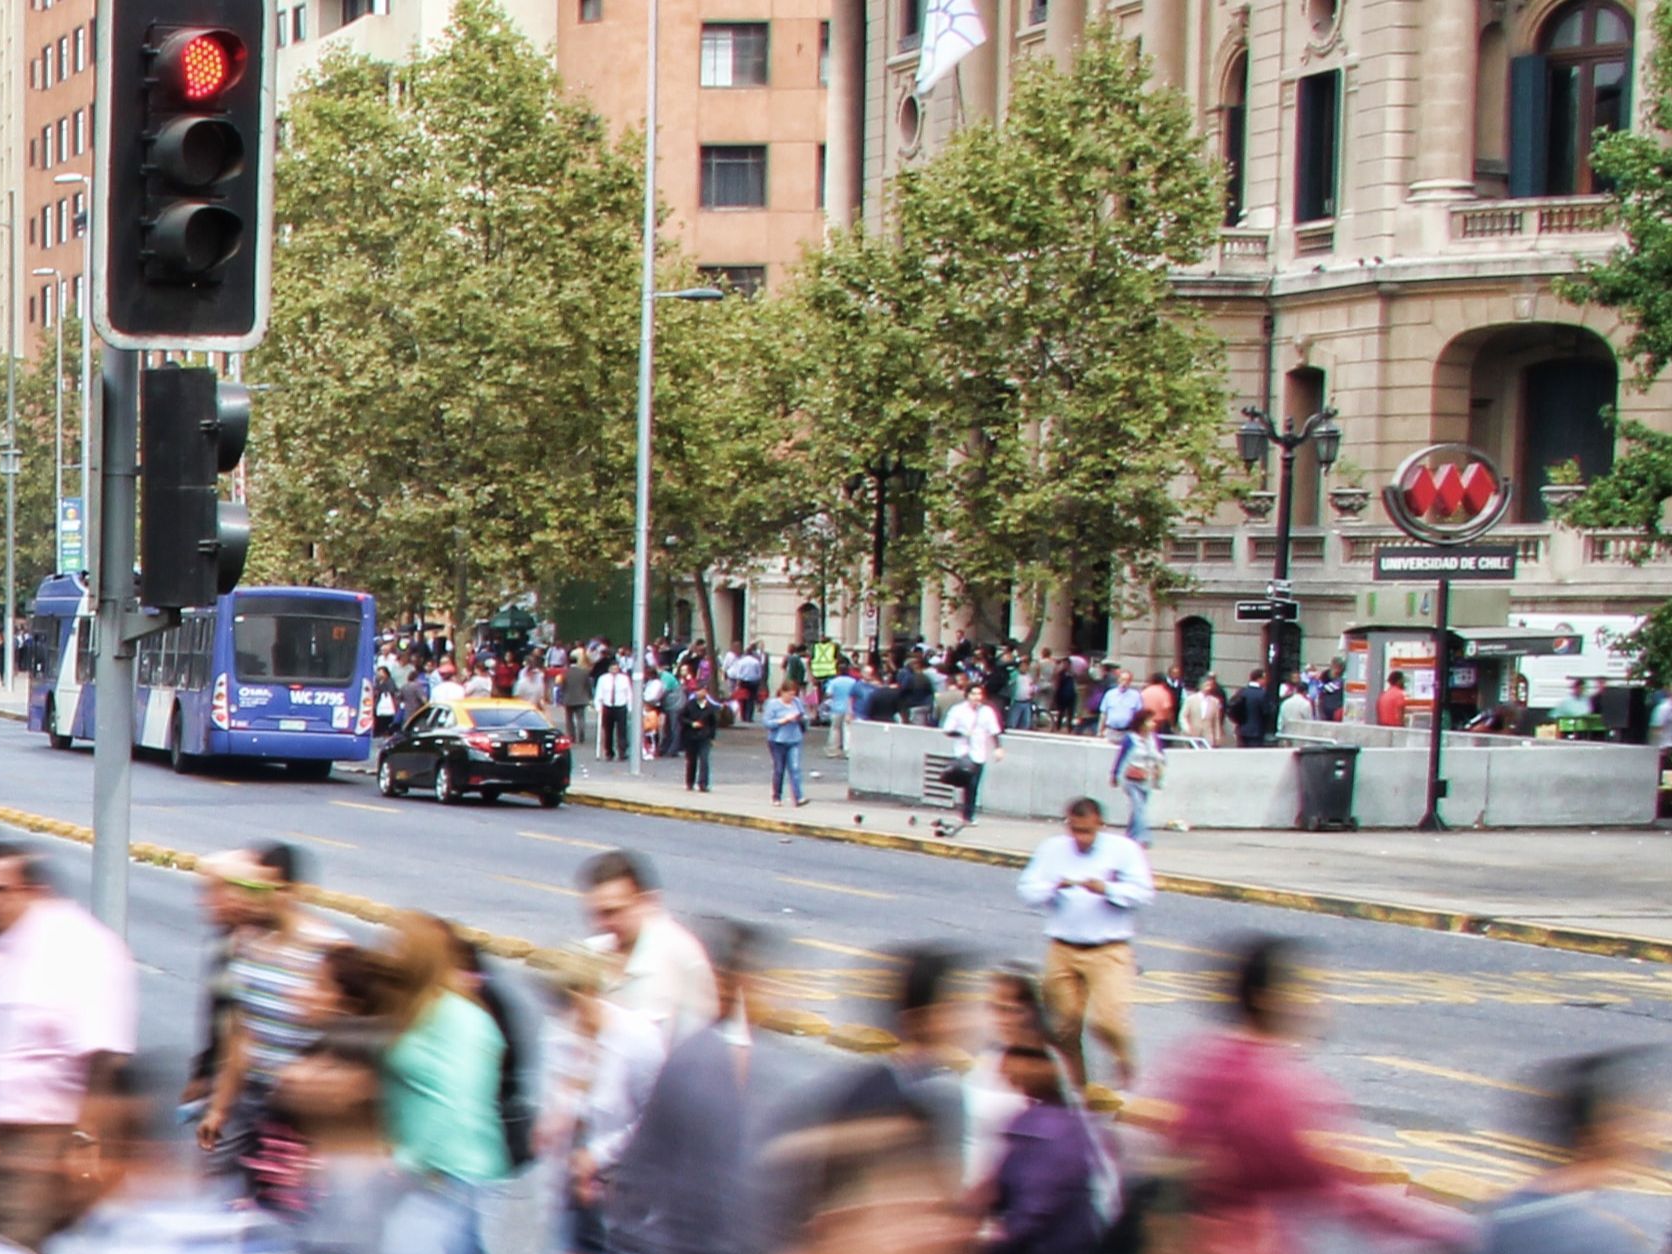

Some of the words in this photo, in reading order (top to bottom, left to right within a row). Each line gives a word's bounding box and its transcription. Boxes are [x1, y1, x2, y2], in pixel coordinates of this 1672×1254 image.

[1380, 556, 1458, 571] UNIVERSIDAD
[1460, 556, 1476, 570] DE
[1478, 556, 1511, 570] CHILE
[289, 690, 313, 704] WC
